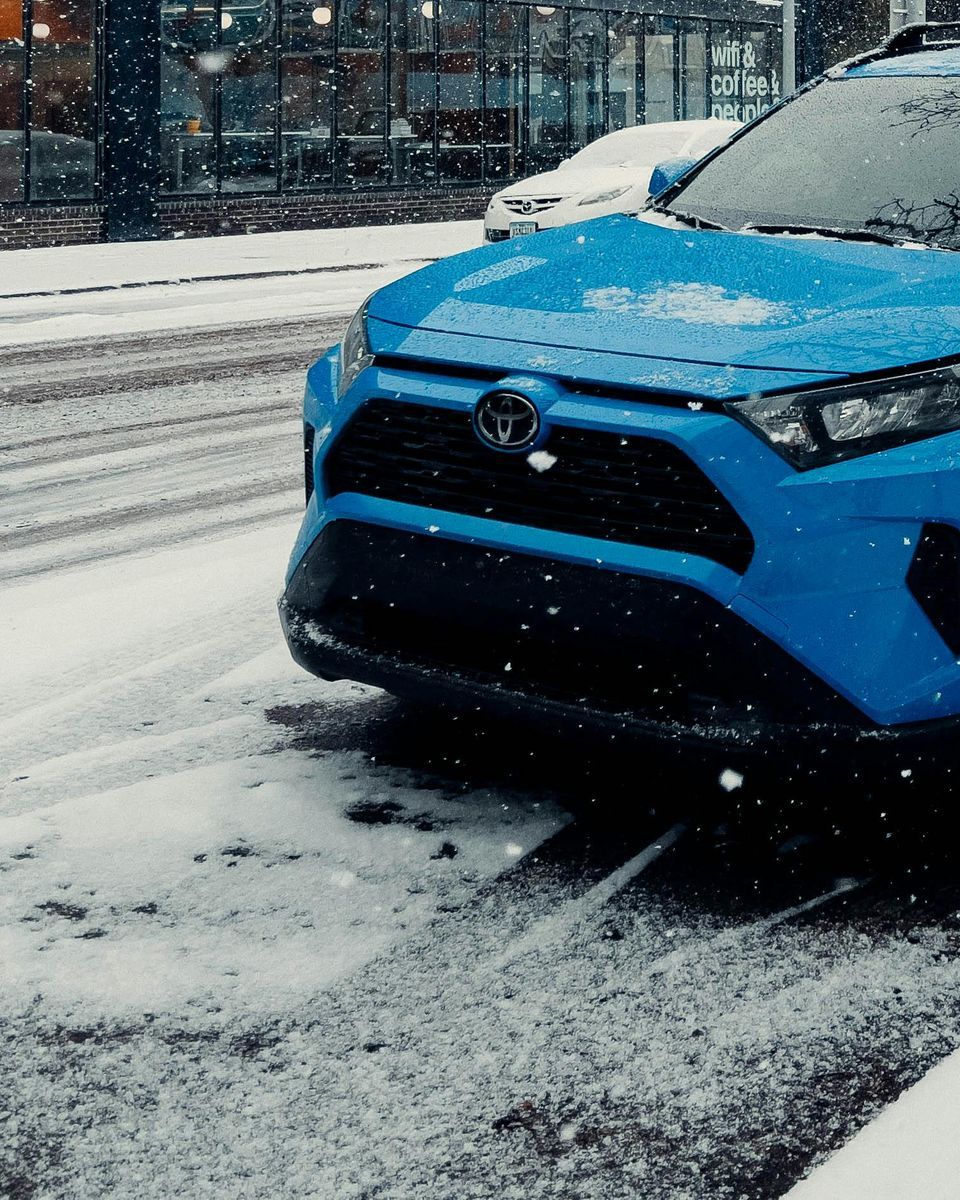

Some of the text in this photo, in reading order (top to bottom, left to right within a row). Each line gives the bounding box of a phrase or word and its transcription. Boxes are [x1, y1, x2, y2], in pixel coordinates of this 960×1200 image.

[711, 40, 756, 68] wifi &
[711, 69, 768, 97] coffee
